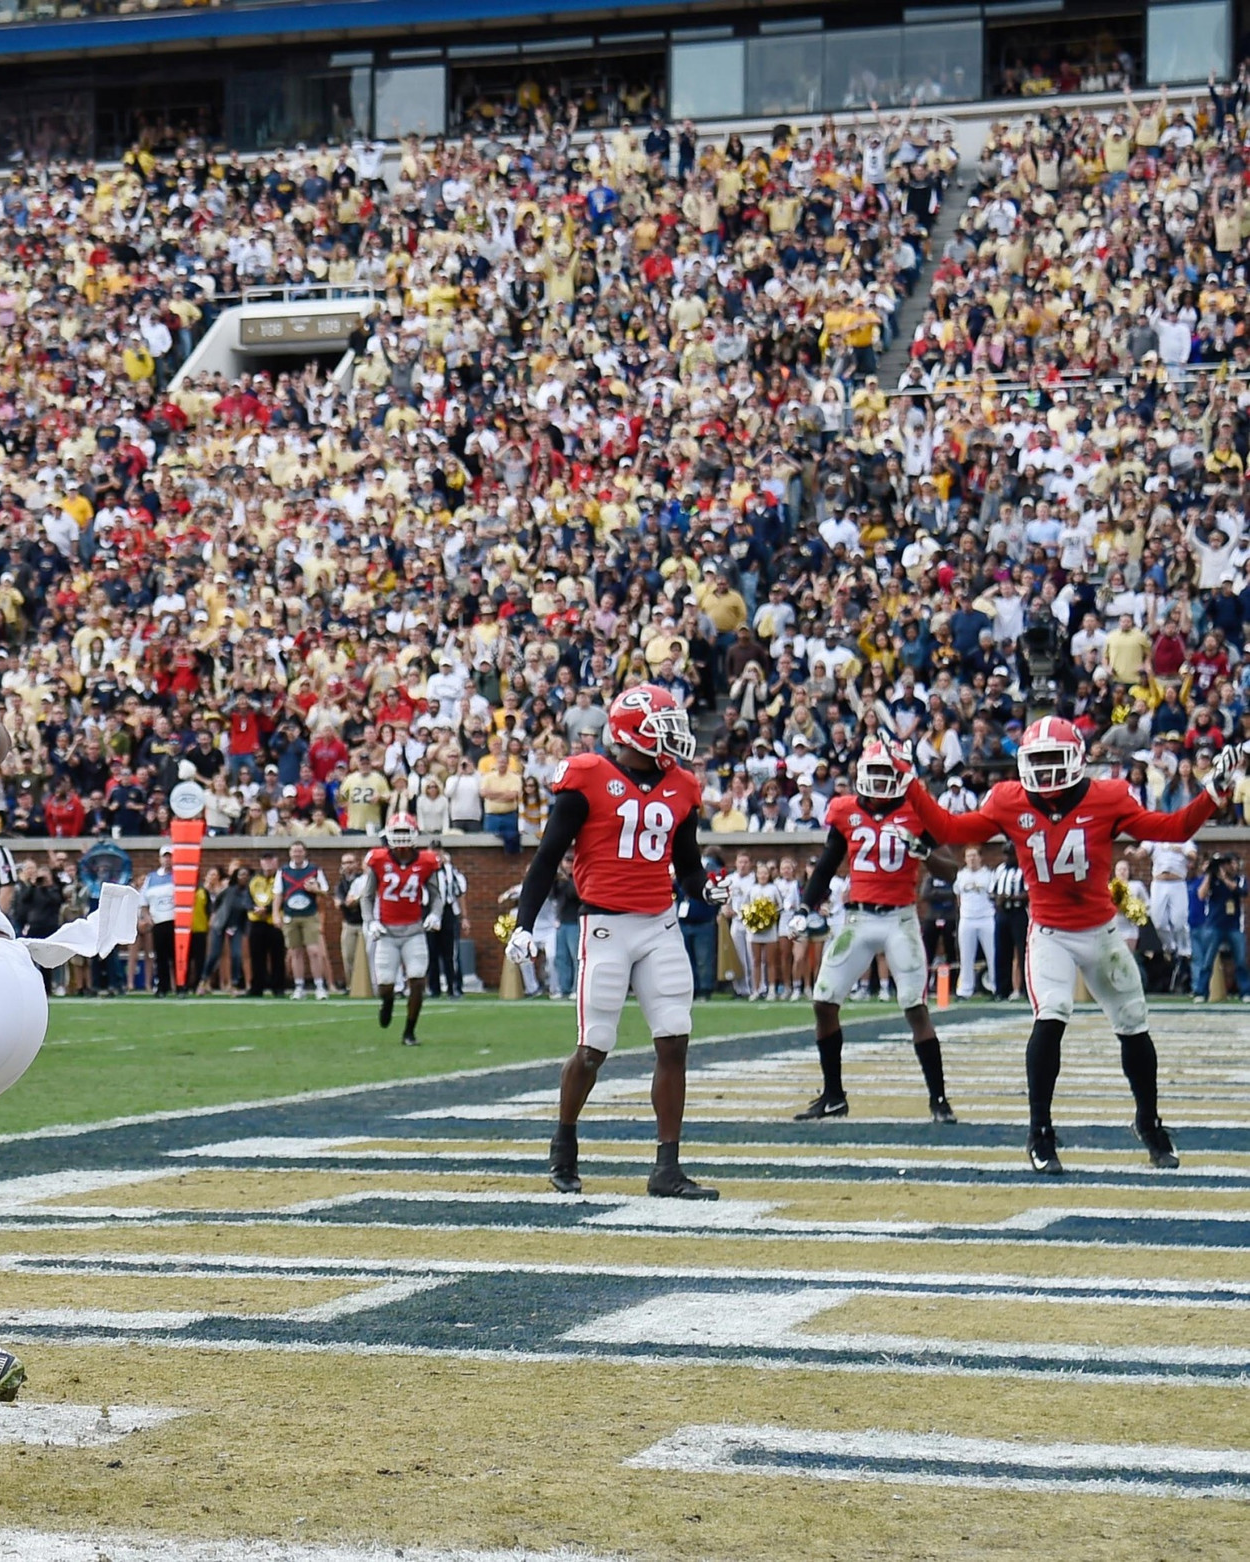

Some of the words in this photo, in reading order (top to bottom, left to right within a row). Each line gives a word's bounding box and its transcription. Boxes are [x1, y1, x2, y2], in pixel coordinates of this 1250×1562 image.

[352, 787, 375, 804] 22
[615, 798, 675, 862] 18
[851, 827, 906, 873] 20
[1026, 828, 1090, 884] 14
[382, 872, 421, 903] 24
[592, 927, 611, 940] G
